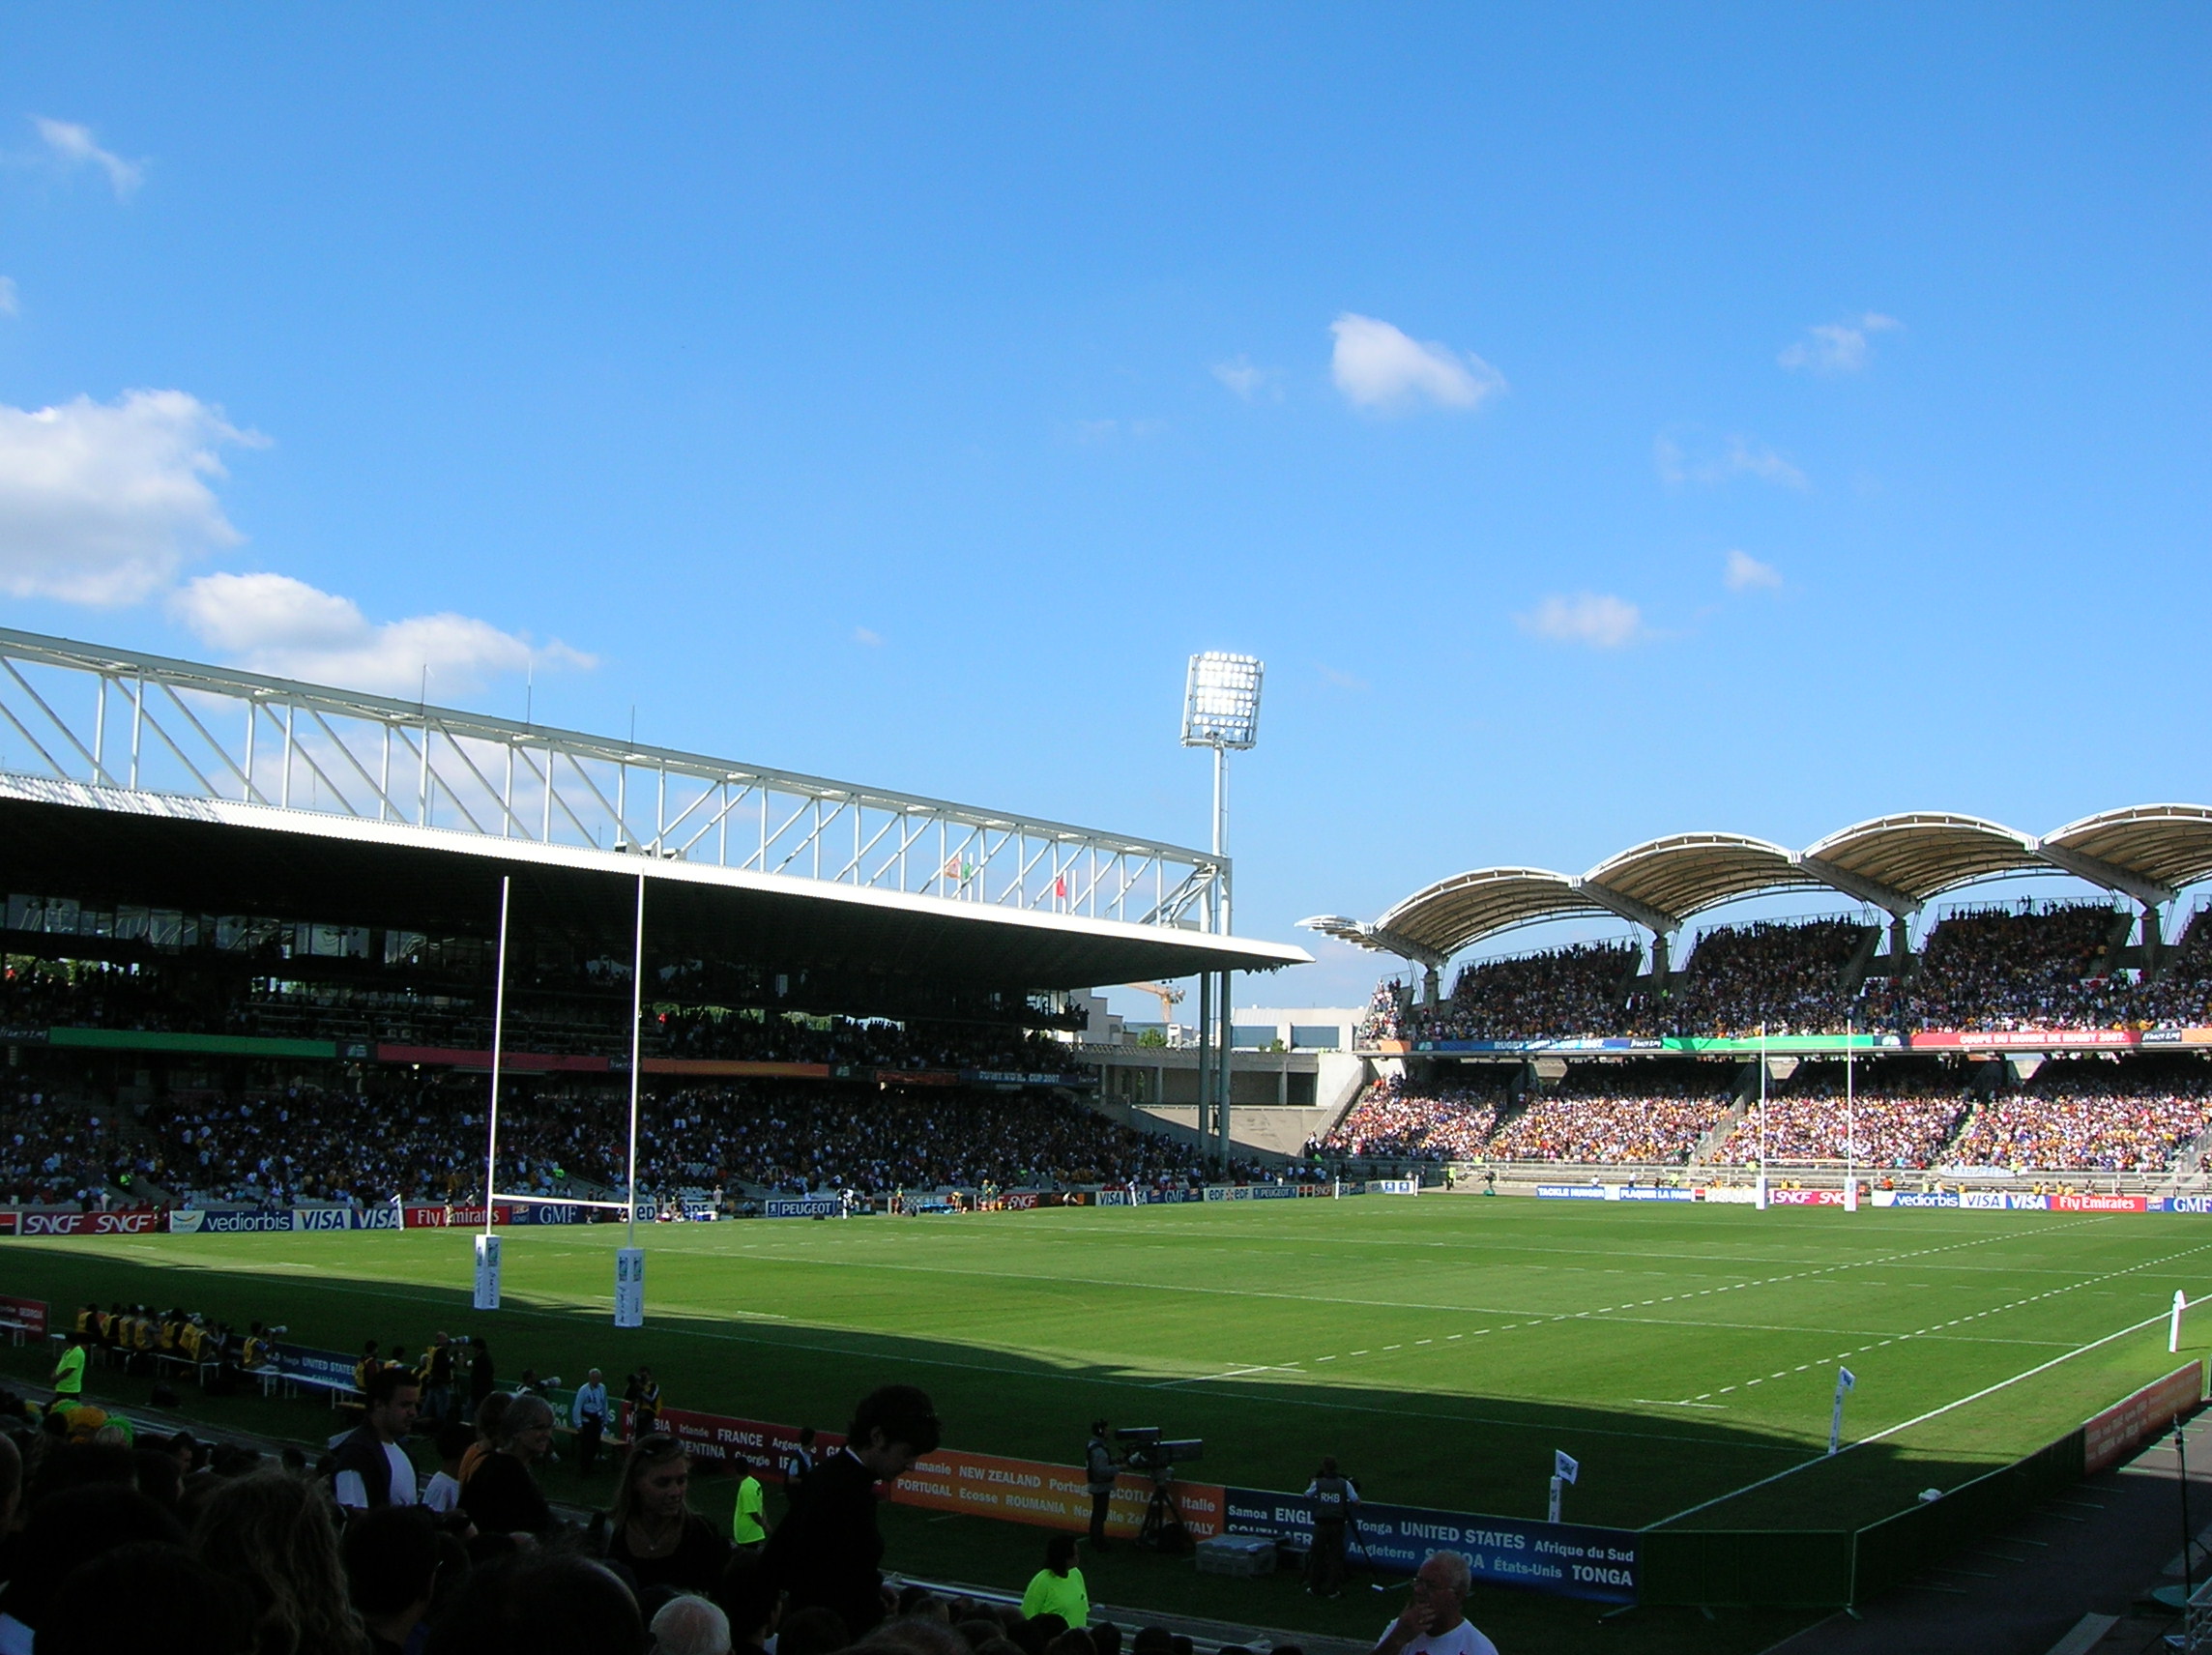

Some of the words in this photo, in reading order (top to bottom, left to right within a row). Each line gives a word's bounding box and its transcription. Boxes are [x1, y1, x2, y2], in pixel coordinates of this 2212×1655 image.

[1960, 1033, 1993, 1043] COUPE
[1994, 1033, 2008, 1043] DU
[2010, 1032, 2046, 1042] MONDE
[2048, 1032, 2060, 1042] DE
[2063, 1032, 2096, 1042] RUGBY
[1494, 1041, 1524, 1050] RUGBY
[1029, 1072, 1042, 1082] CUP
[1043, 1073, 1060, 1084] 2007
[1099, 1193, 1121, 1205] VISA
[1261, 1188, 1290, 1198] PEUGEOT
[1538, 1188, 1569, 1197] TACKLE
[1658, 1190, 1670, 1199] LA
[1775, 1191, 1811, 1205] SNCF
[1819, 1192, 1846, 1205] SNC
[1011, 1194, 1037, 1207] SNCF
[1897, 1193, 1959, 1207] vediorbis
[1966, 1195, 2000, 1207] VISA
[2010, 1195, 2048, 1209] VISA
[2059, 1197, 2079, 1210] Fly
[2081, 1196, 2135, 1209] Emirates
[2173, 1198, 2212, 1212] GMF
[539, 1205, 578, 1225] GMF
[781, 1203, 832, 1215] PEUGEOT
[24, 1215, 84, 1234] SNCF
[95, 1214, 152, 1233] SNCF
[207, 1210, 290, 1232] vediorbis
[300, 1210, 346, 1230] VISA
[358, 1209, 400, 1229] VISA
[417, 1209, 440, 1227] Fly
[303, 1356, 329, 1371] UNITED
[679, 1424, 710, 1438] Irlande
[717, 1429, 764, 1447] FRANCE
[959, 1466, 985, 1480] NEW
[988, 1469, 1041, 1489] ZEALAND
[1049, 1478, 1091, 1497] Portug
[1182, 1496, 1215, 1512] Italie
[897, 1478, 952, 1497] PORTUGAL
[959, 1488, 998, 1504] Ecosse
[1005, 1495, 1066, 1515] ROUMANIA
[1321, 1493, 1341, 1503] RHB
[1228, 1504, 1267, 1520] Samoa
[1275, 1507, 1315, 1525] ENGL
[1356, 1519, 1392, 1535] Tonga
[1401, 1521, 1459, 1542] UNITED
[1465, 1530, 1526, 1551] STATES
[1534, 1539, 1585, 1557] Afrique
[1587, 1547, 1604, 1560] du
[1607, 1549, 1634, 1563] Sud
[1348, 1542, 1415, 1560] Angleterre
[1494, 1556, 1563, 1579] États-Unis
[1572, 1563, 1634, 1586] TONGA
